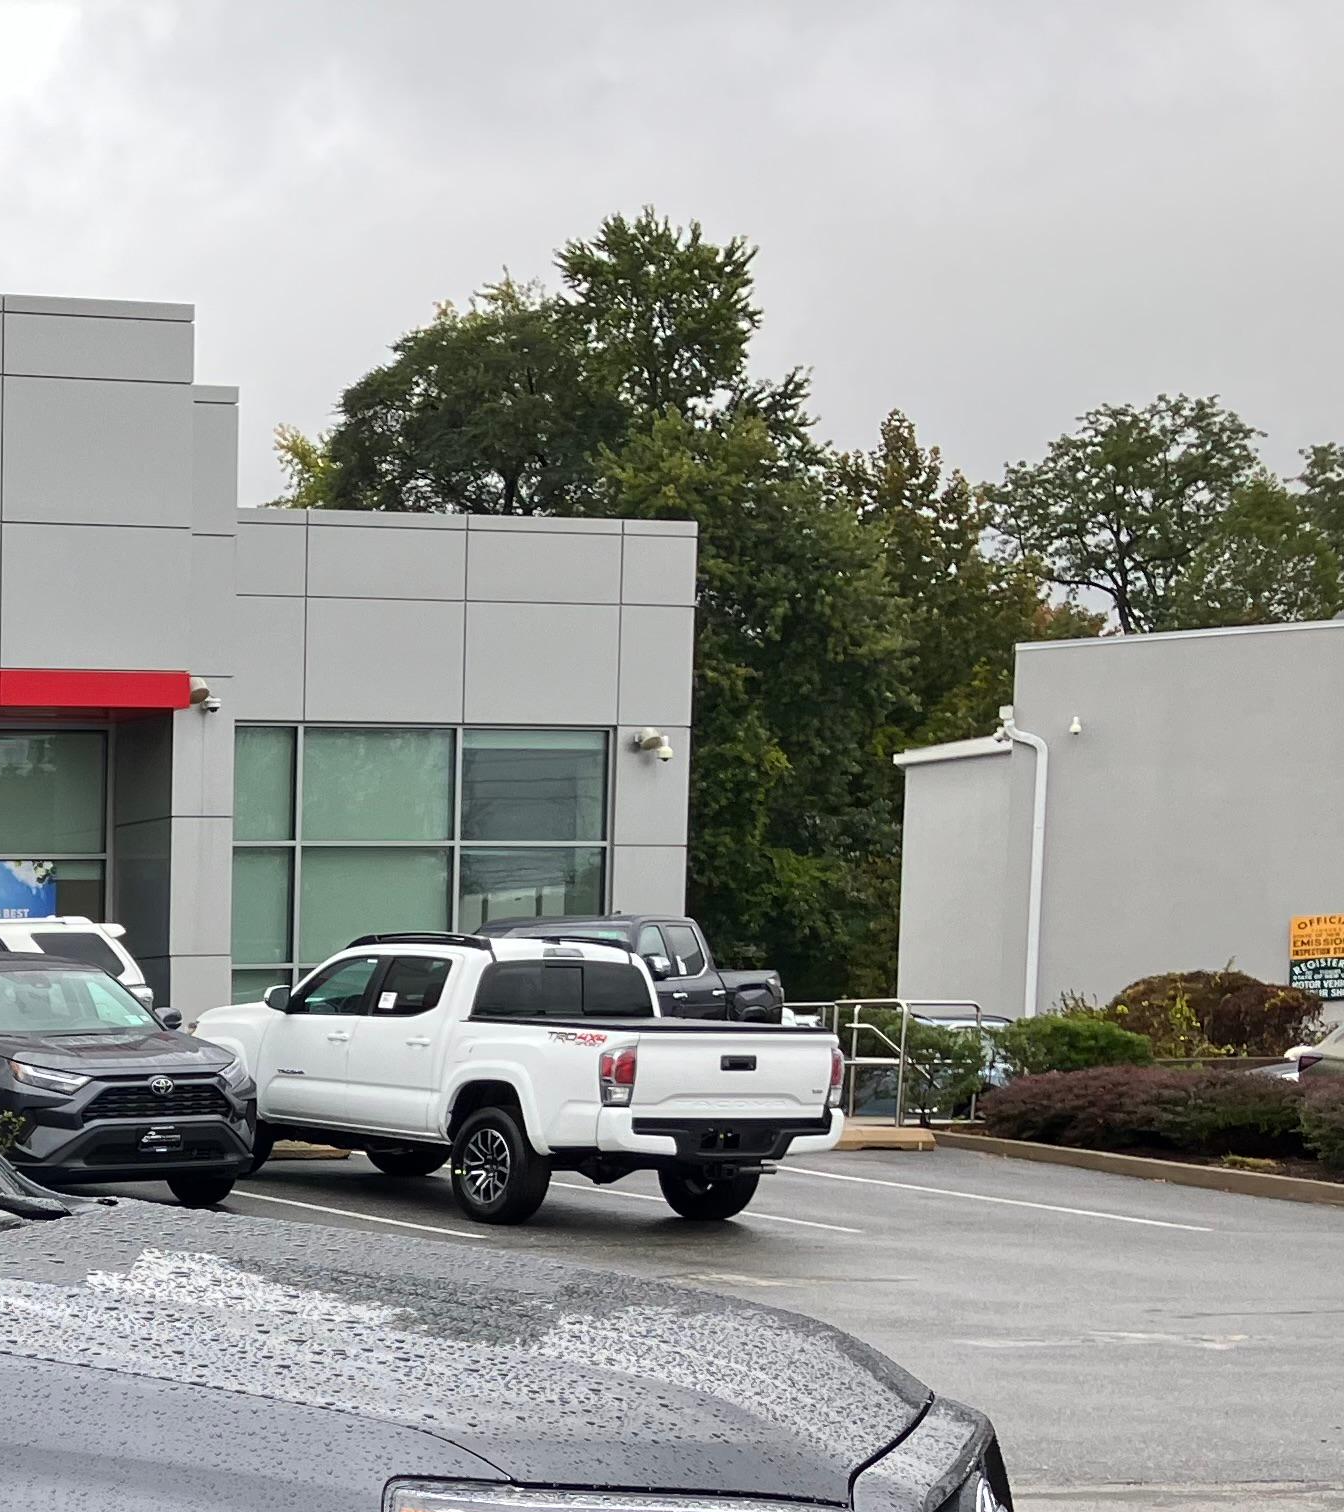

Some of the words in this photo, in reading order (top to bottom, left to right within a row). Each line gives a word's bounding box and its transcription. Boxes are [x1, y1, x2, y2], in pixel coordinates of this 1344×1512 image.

[3, 908, 30, 918] BEST
[1297, 916, 1344, 930] OFFICI
[1293, 937, 1344, 948] EMISSIO
